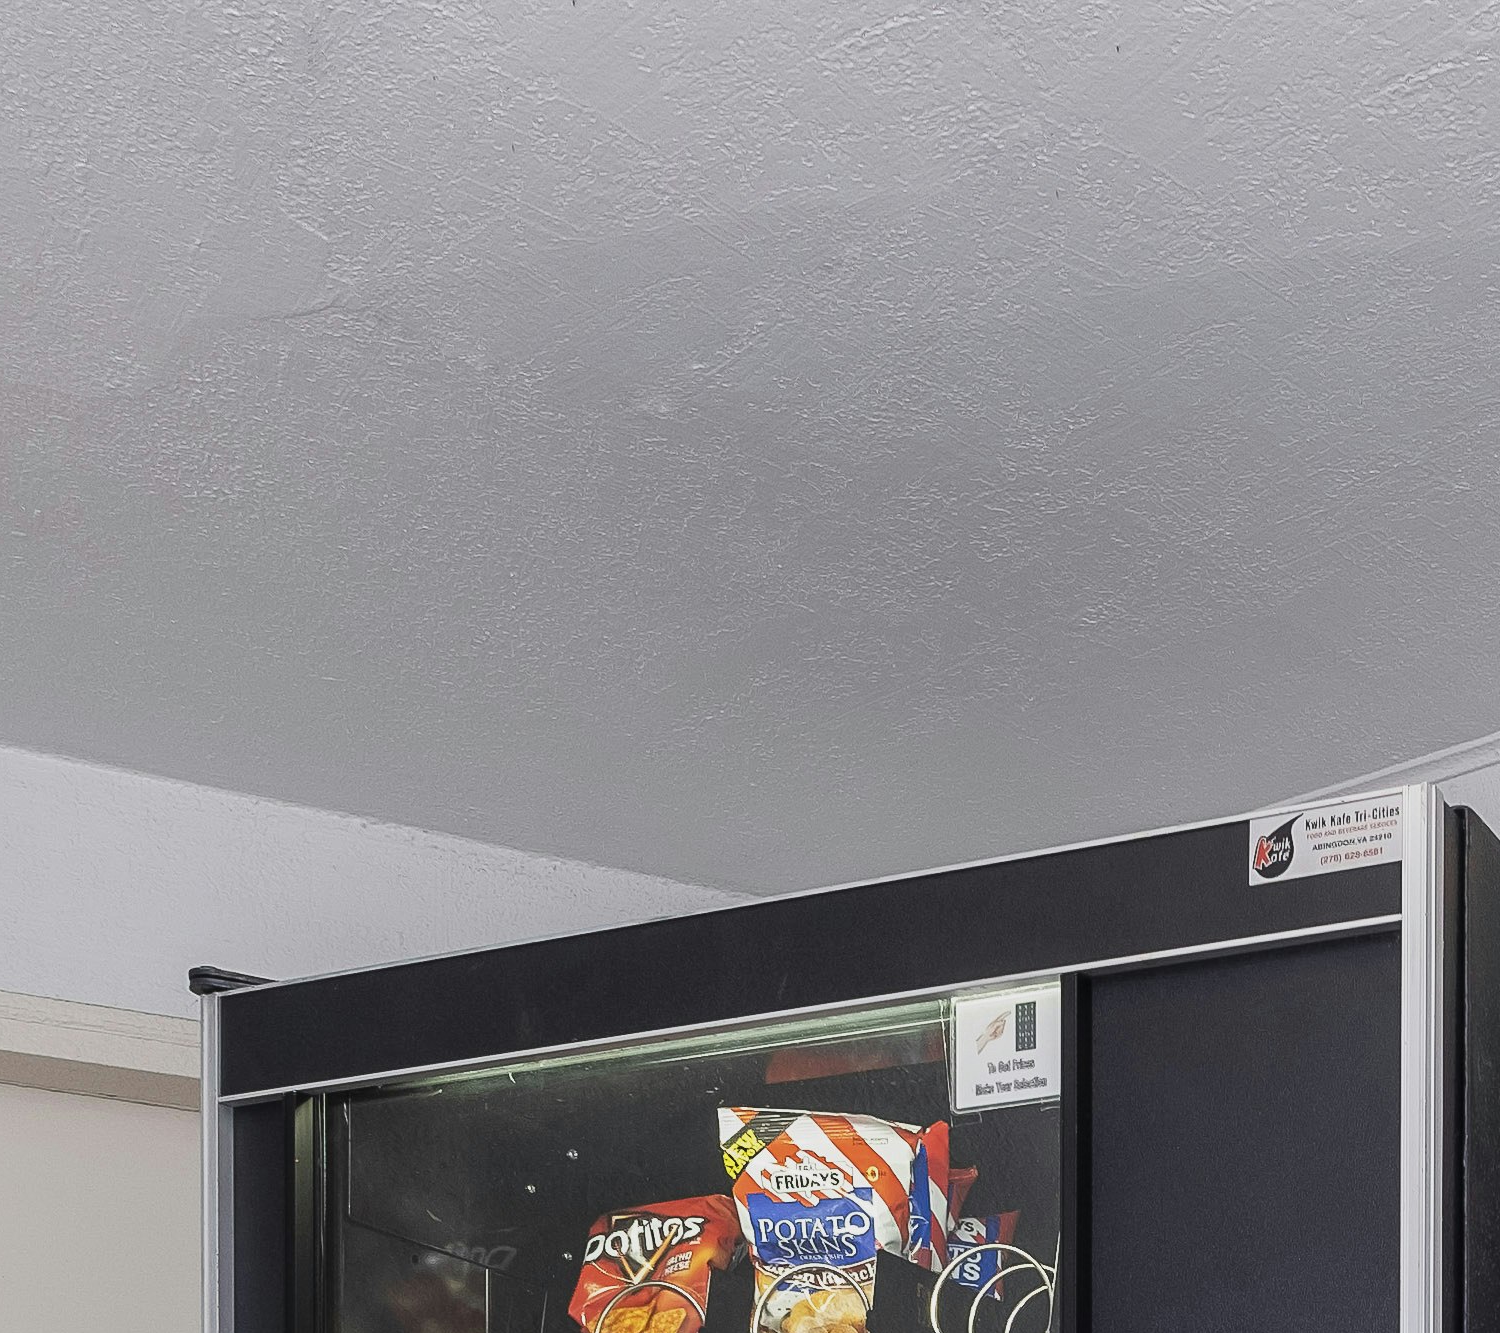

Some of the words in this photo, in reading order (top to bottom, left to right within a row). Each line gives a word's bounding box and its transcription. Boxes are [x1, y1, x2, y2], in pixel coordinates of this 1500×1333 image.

[1305, 816, 1327, 832] Kwik
[1330, 812, 1351, 828] Kafe
[1354, 806, 1400, 822] Tri-Cities
[987, 1062, 996, 1074] To
[998, 1060, 1011, 1072] Get
[1012, 1058, 1035, 1071] Prices
[975, 1083, 994, 1096] Make
[996, 1080, 1012, 1093] Your
[1013, 1076, 1048, 1090] Selection
[757, 1211, 872, 1243] POTATO
[778, 1233, 858, 1259] SKINS
